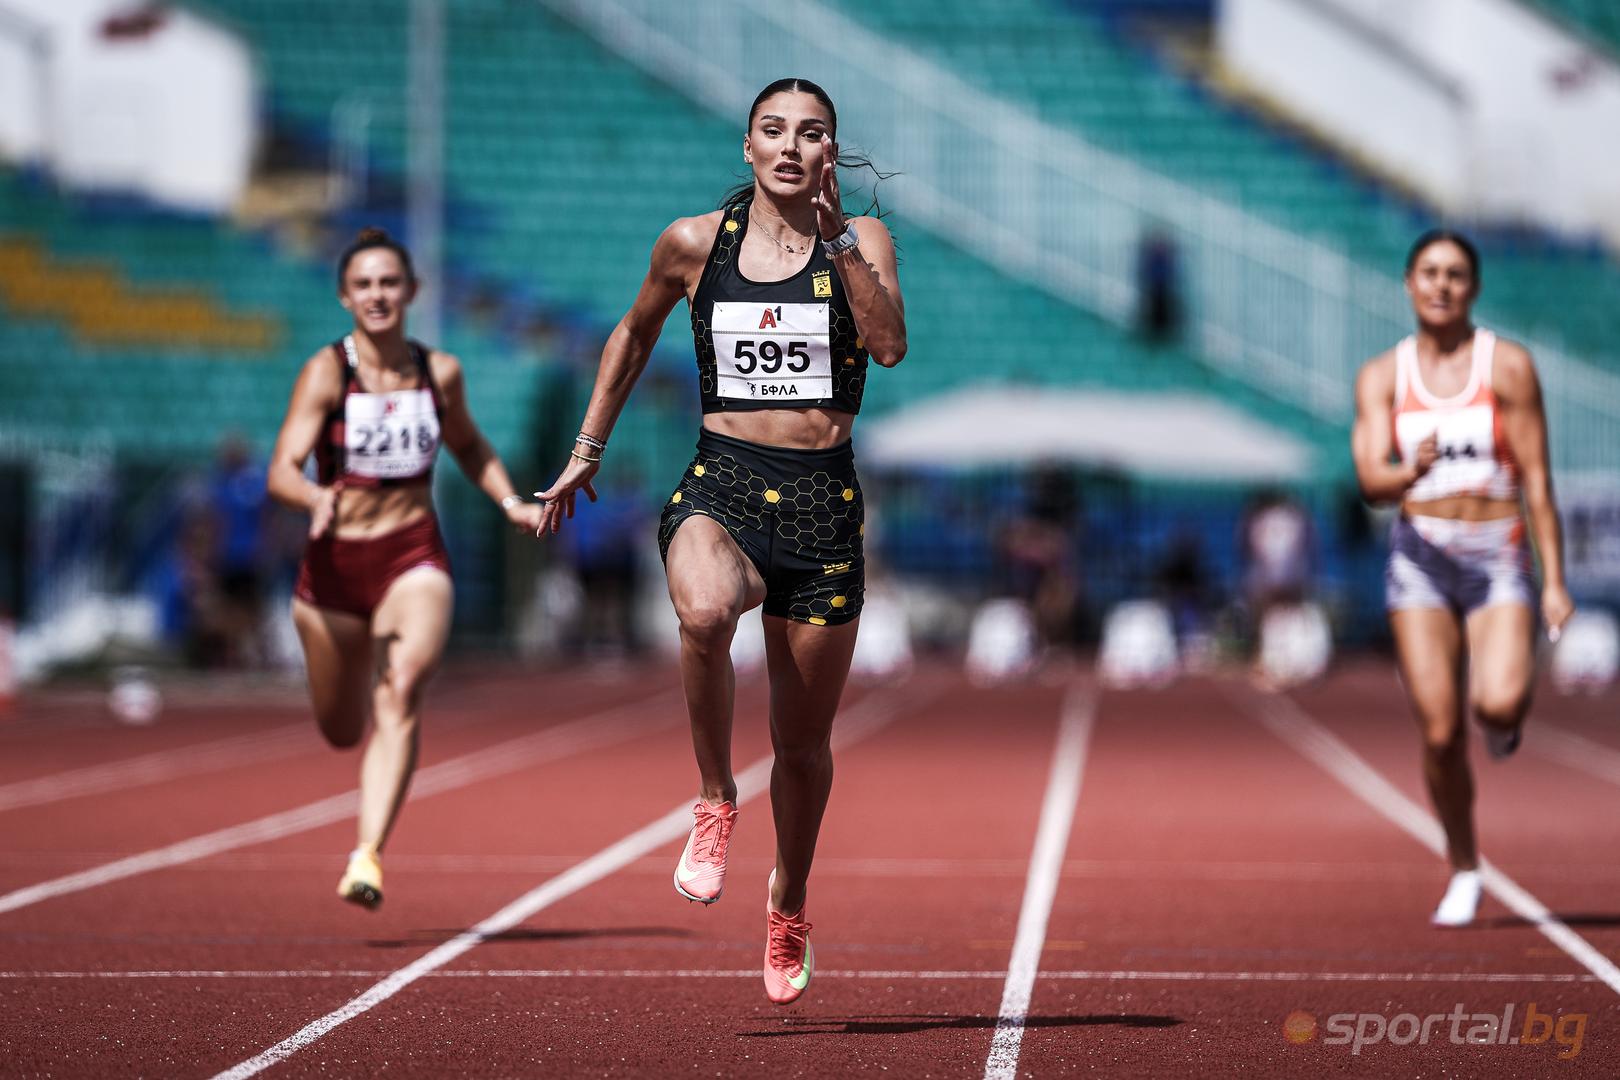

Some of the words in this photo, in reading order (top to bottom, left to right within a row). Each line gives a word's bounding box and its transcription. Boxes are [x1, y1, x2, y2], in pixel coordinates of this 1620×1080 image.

[759, 305, 782, 329] A1
[734, 340, 811, 374] 595
[761, 384, 799, 396] БФЛА
